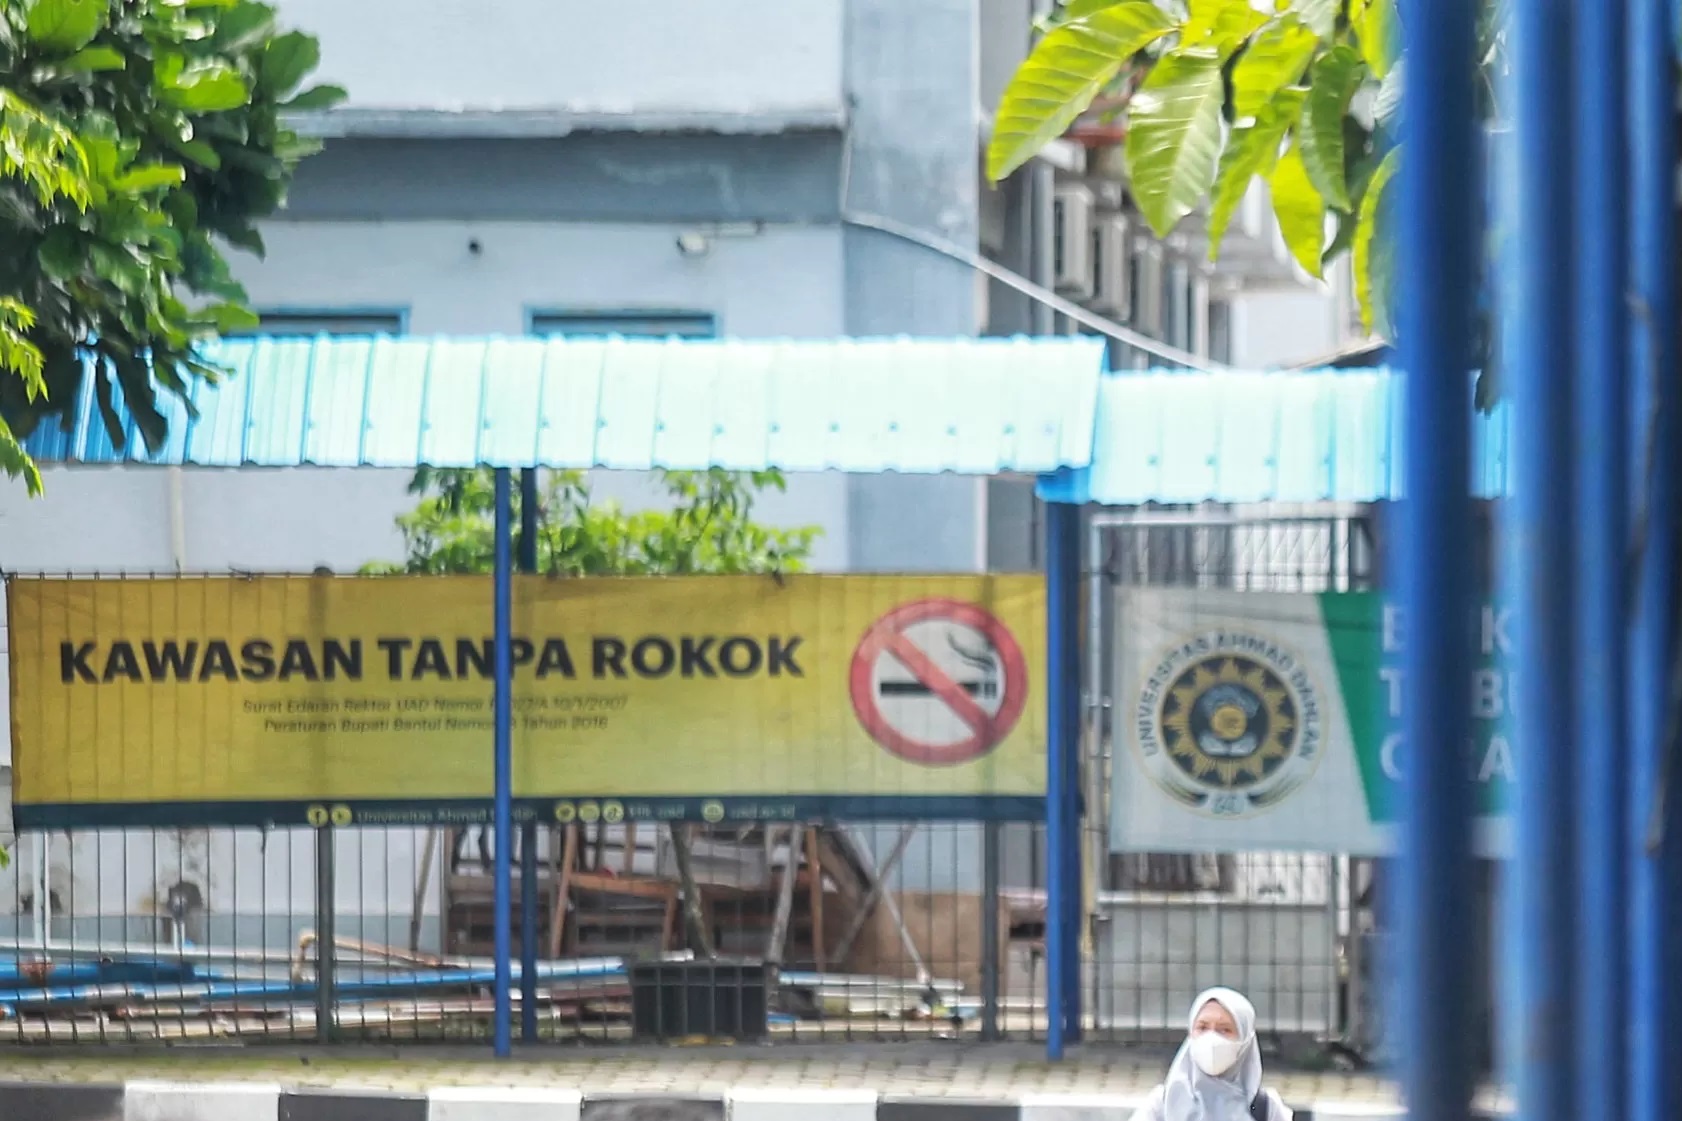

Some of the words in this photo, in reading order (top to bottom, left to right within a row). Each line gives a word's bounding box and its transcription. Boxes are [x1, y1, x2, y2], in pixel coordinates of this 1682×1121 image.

[60, 638, 363, 684] KAWASAN
[377, 636, 577, 681] TANPA
[592, 634, 806, 680] ROKOK
[287, 698, 339, 713] Edaran
[264, 719, 337, 733] Peraturan
[342, 719, 389, 735] Bupati
